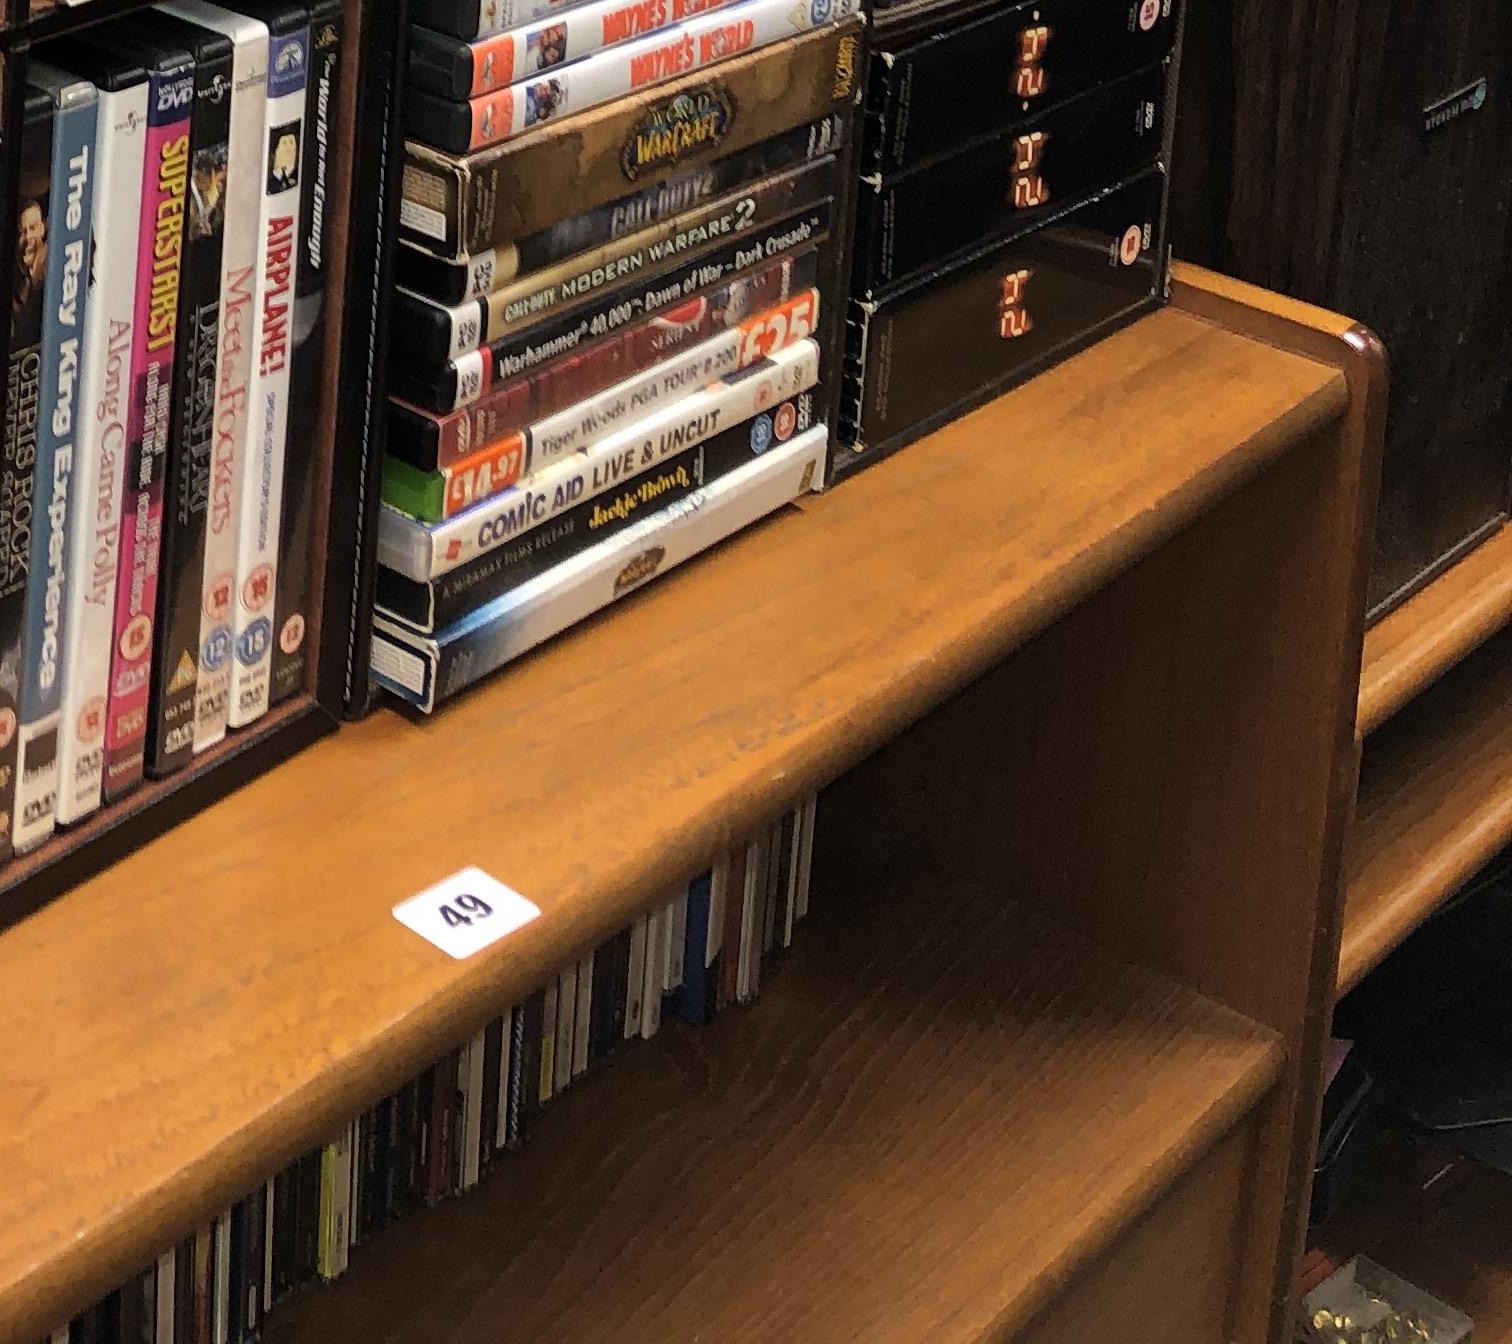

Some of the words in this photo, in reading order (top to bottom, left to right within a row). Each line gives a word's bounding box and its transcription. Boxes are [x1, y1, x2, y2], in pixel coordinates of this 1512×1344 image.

[630, 42, 696, 89] WAYNE'S
[698, 19, 755, 63] WORLD
[64, 144, 89, 231] The
[58, 238, 85, 328] Ray
[259, 214, 294, 379] AIRPLANE!
[560, 255, 645, 298] MODERN
[649, 220, 731, 260] WARFARE
[733, 198, 757, 231] 2
[95, 315, 131, 422] Along
[738, 302, 811, 369] £25
[52, 337, 78, 438] King
[94, 420, 125, 527] Came
[476, 491, 547, 549] COMIC
[550, 473, 586, 512] AID
[591, 453, 636, 493] LIVE
[640, 444, 655, 467] &
[660, 411, 723, 453] UNCUT
[39, 443, 73, 692] Experience
[84, 526, 119, 608] Polly
[438, 893, 494, 929] 49
